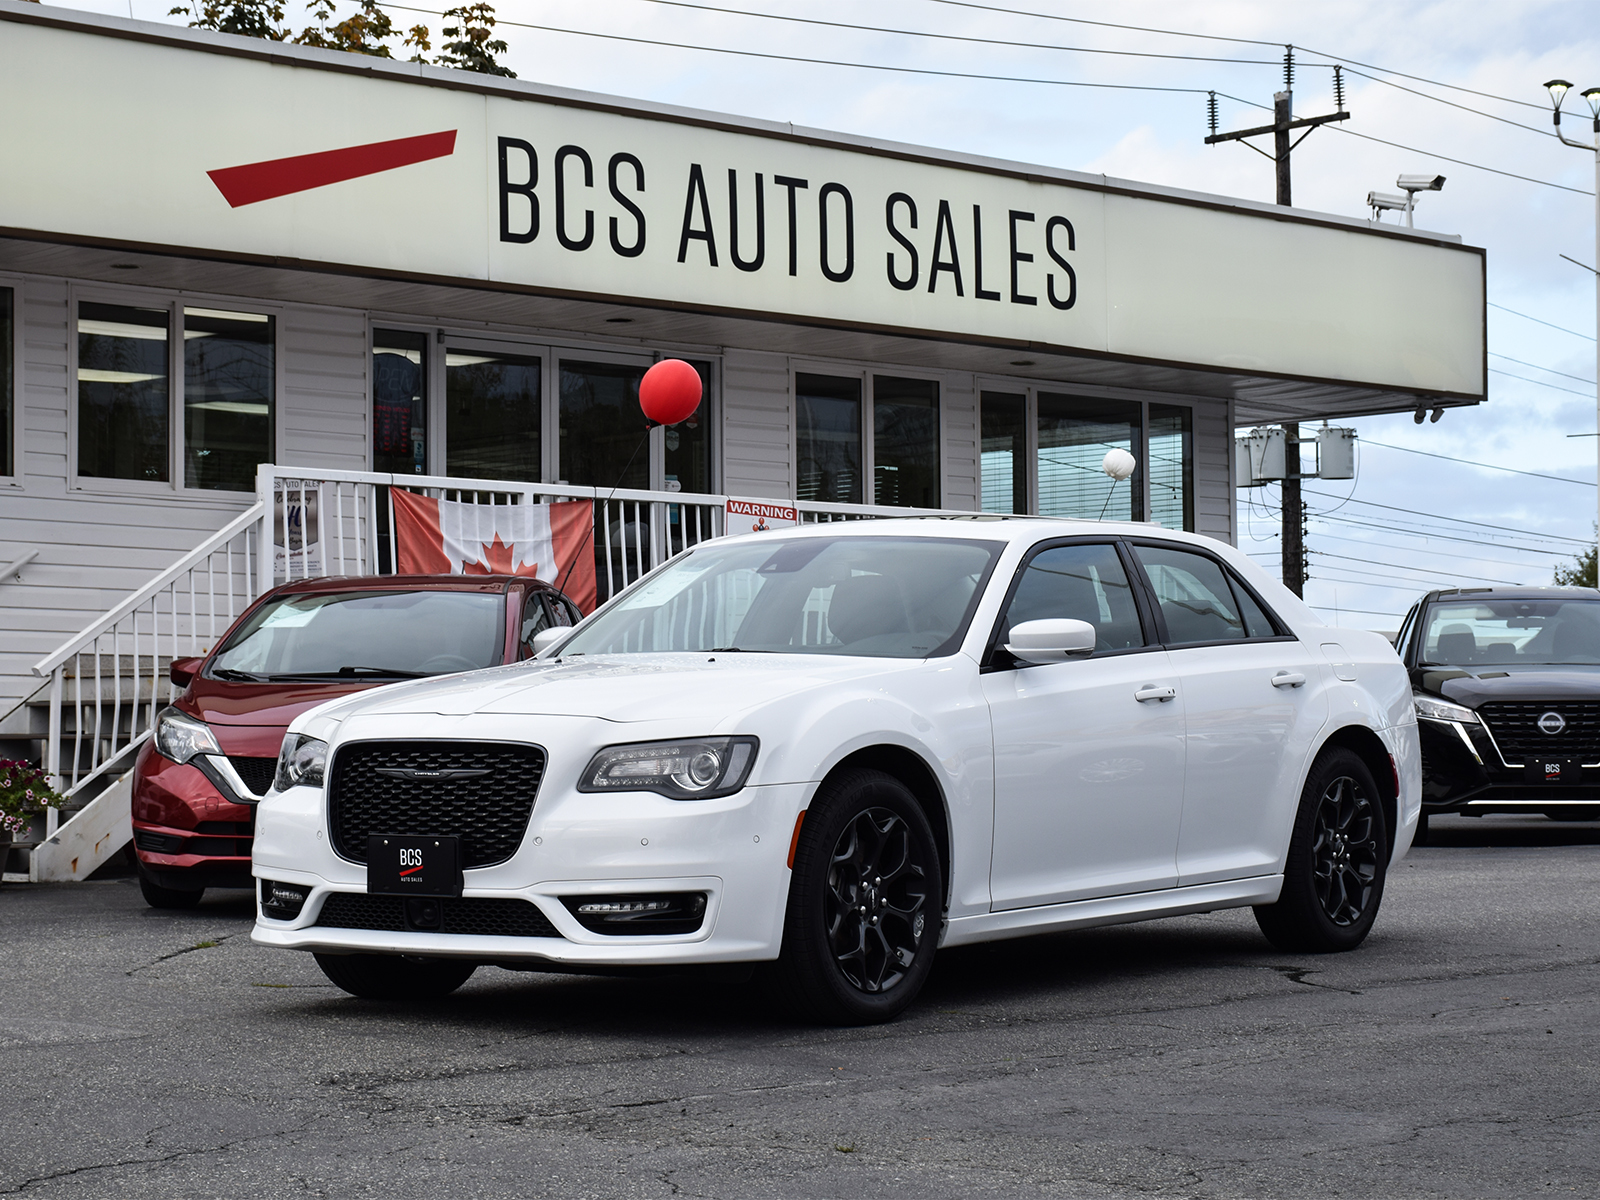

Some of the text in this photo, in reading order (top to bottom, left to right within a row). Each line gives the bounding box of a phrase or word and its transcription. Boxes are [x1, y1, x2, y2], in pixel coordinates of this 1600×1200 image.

[497, 136, 1077, 310] BCS AUTO SALES
[286, 480, 299, 489] UTO
[304, 479, 319, 488] ALES
[729, 501, 794, 520] WARNING
[1545, 763, 1561, 773] BCS
[399, 848, 422, 867] BCS
